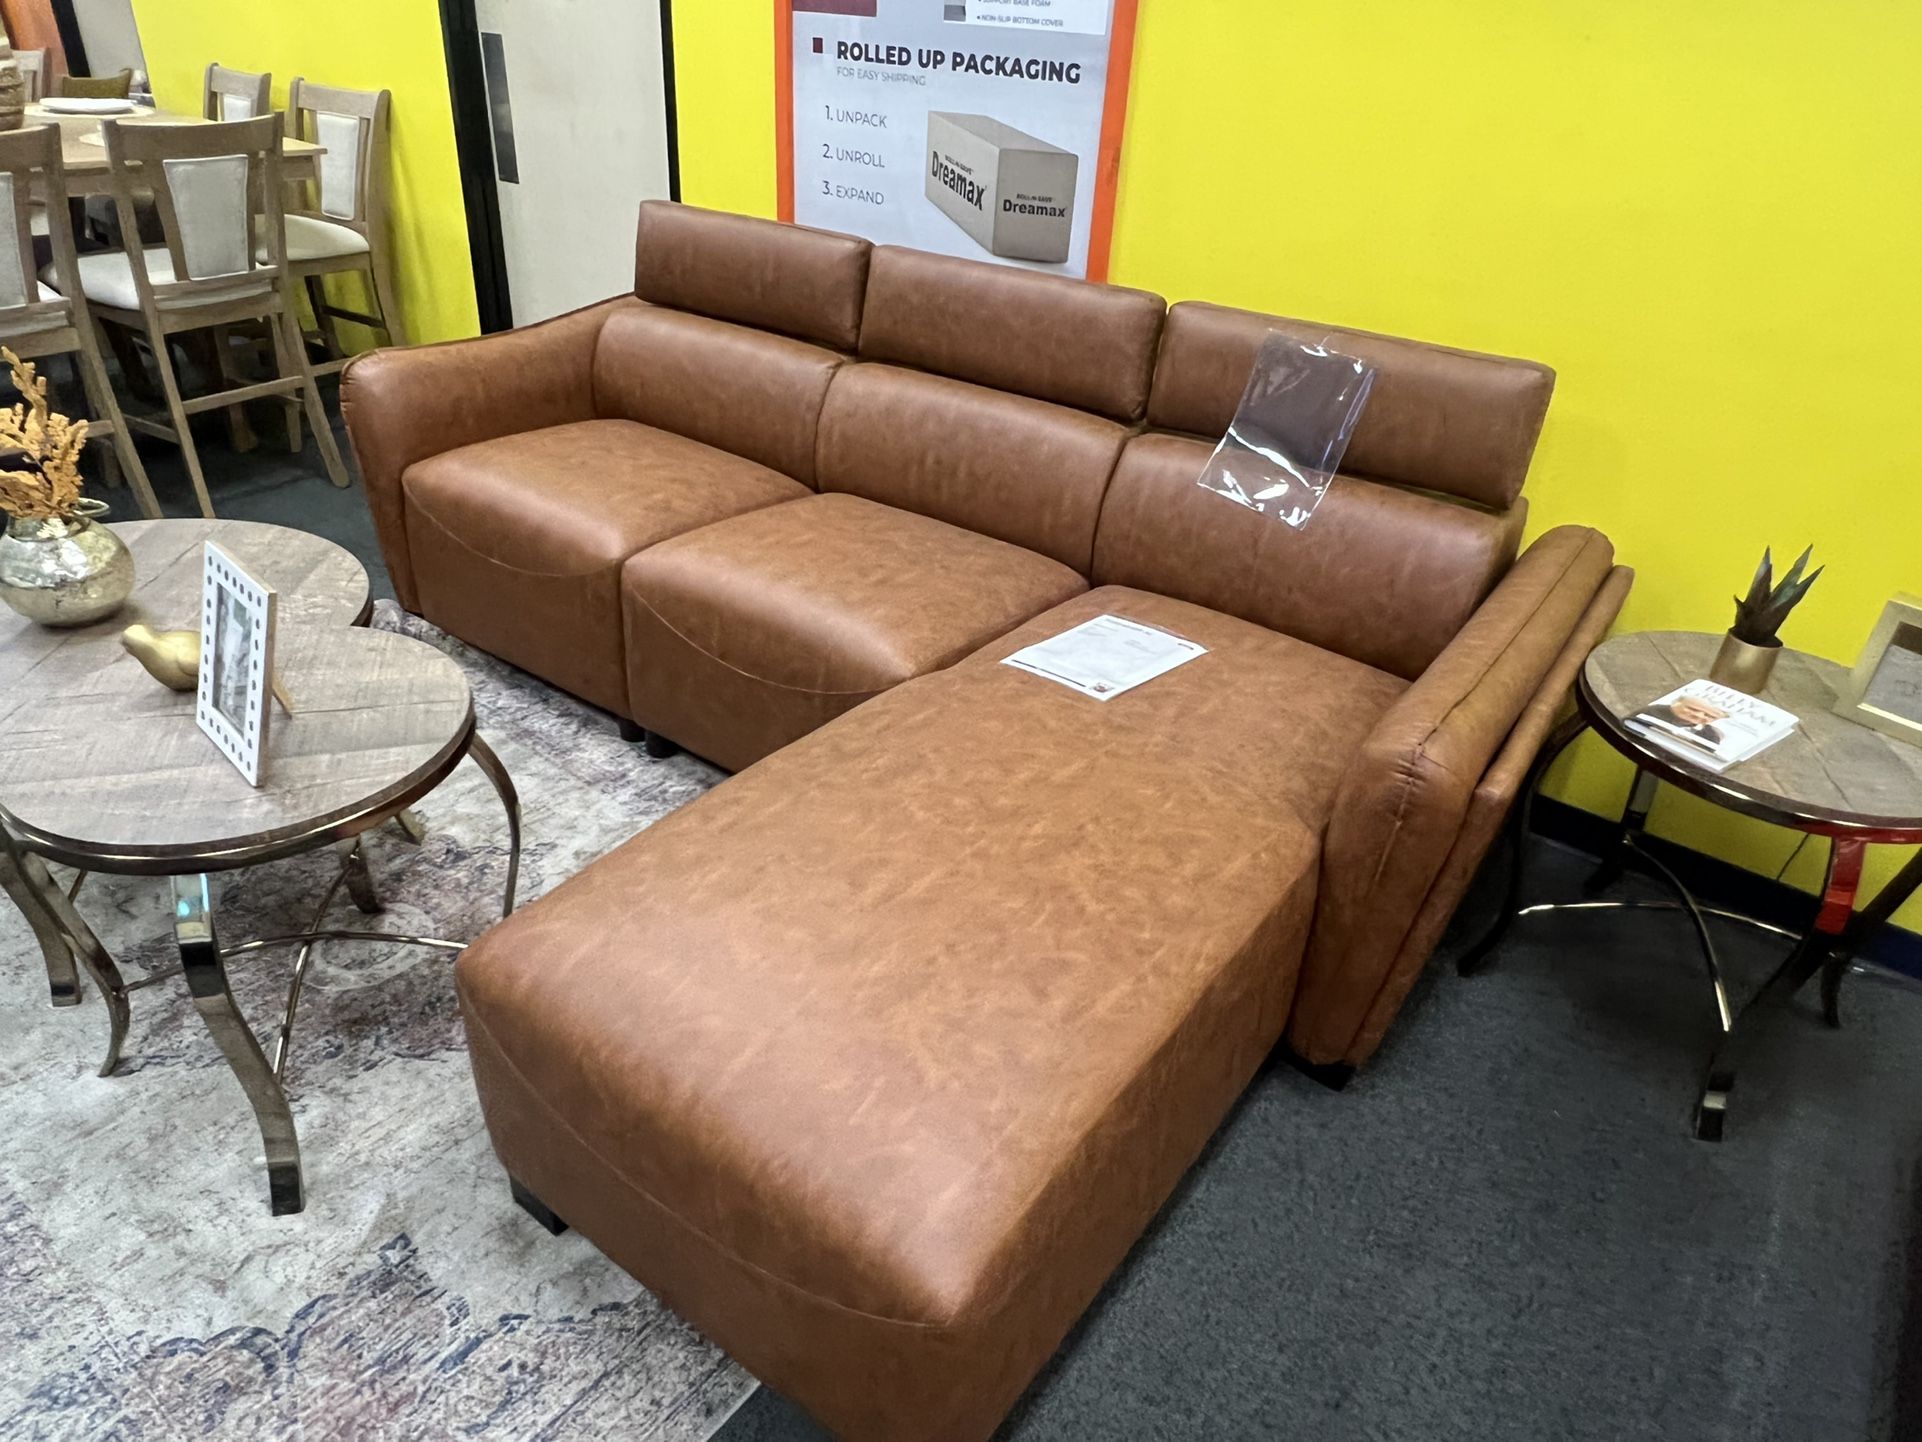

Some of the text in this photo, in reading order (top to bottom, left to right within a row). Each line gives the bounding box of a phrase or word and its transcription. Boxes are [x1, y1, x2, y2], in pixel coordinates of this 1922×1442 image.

[1012, 16, 1040, 24] BOTTOM
[1041, 18, 1063, 26] COVER
[837, 40, 1081, 84] ROLLED UP PACKAGING
[837, 66, 926, 86] FOR EASY SHIPPING
[825, 104, 888, 129] 1. UNPACK
[822, 143, 886, 169] 2. UNROLL
[822, 179, 885, 205] 3. EXPAND
[931, 150, 985, 211] Dreamax
[1003, 199, 1067, 218] Dreamax
